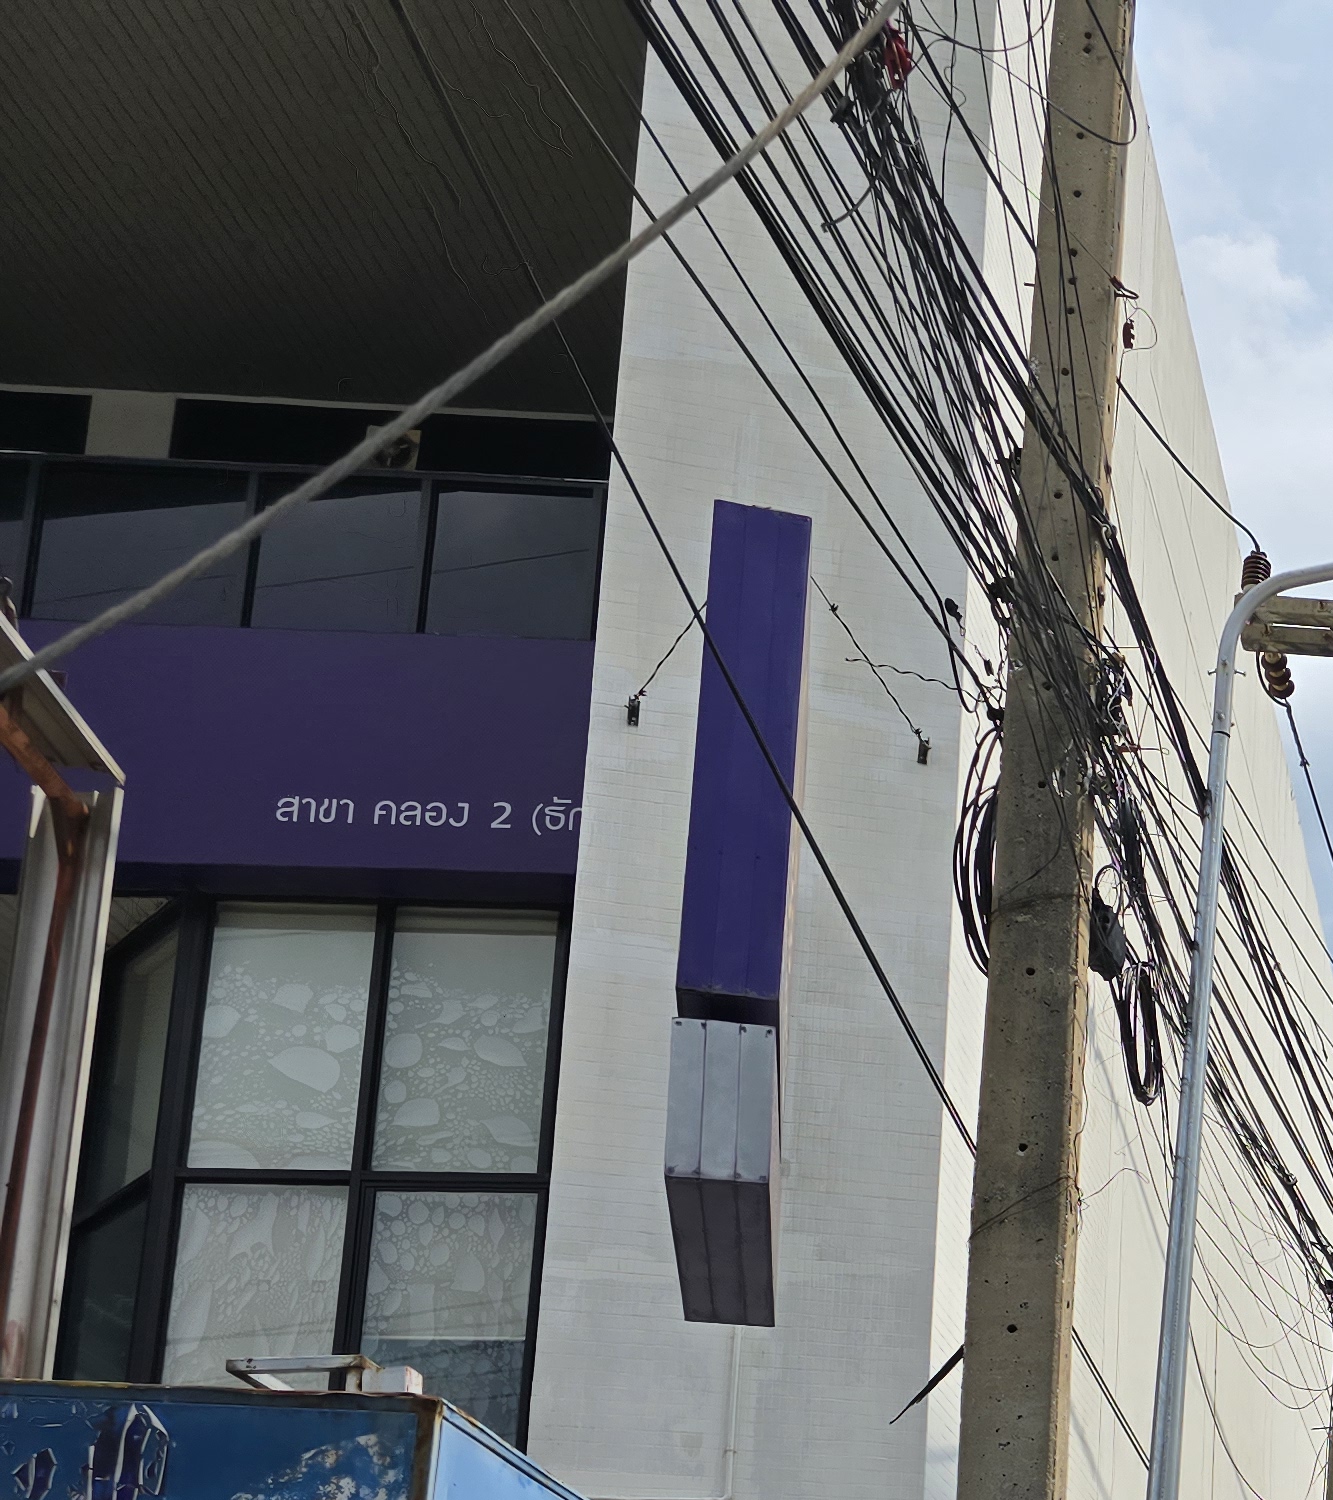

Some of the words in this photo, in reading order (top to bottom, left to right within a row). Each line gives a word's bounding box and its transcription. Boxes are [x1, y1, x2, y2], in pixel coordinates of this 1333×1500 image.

[275, 795, 355, 824] สาขา
[373, 799, 470, 828] คลอง
[490, 801, 512, 829] 2
